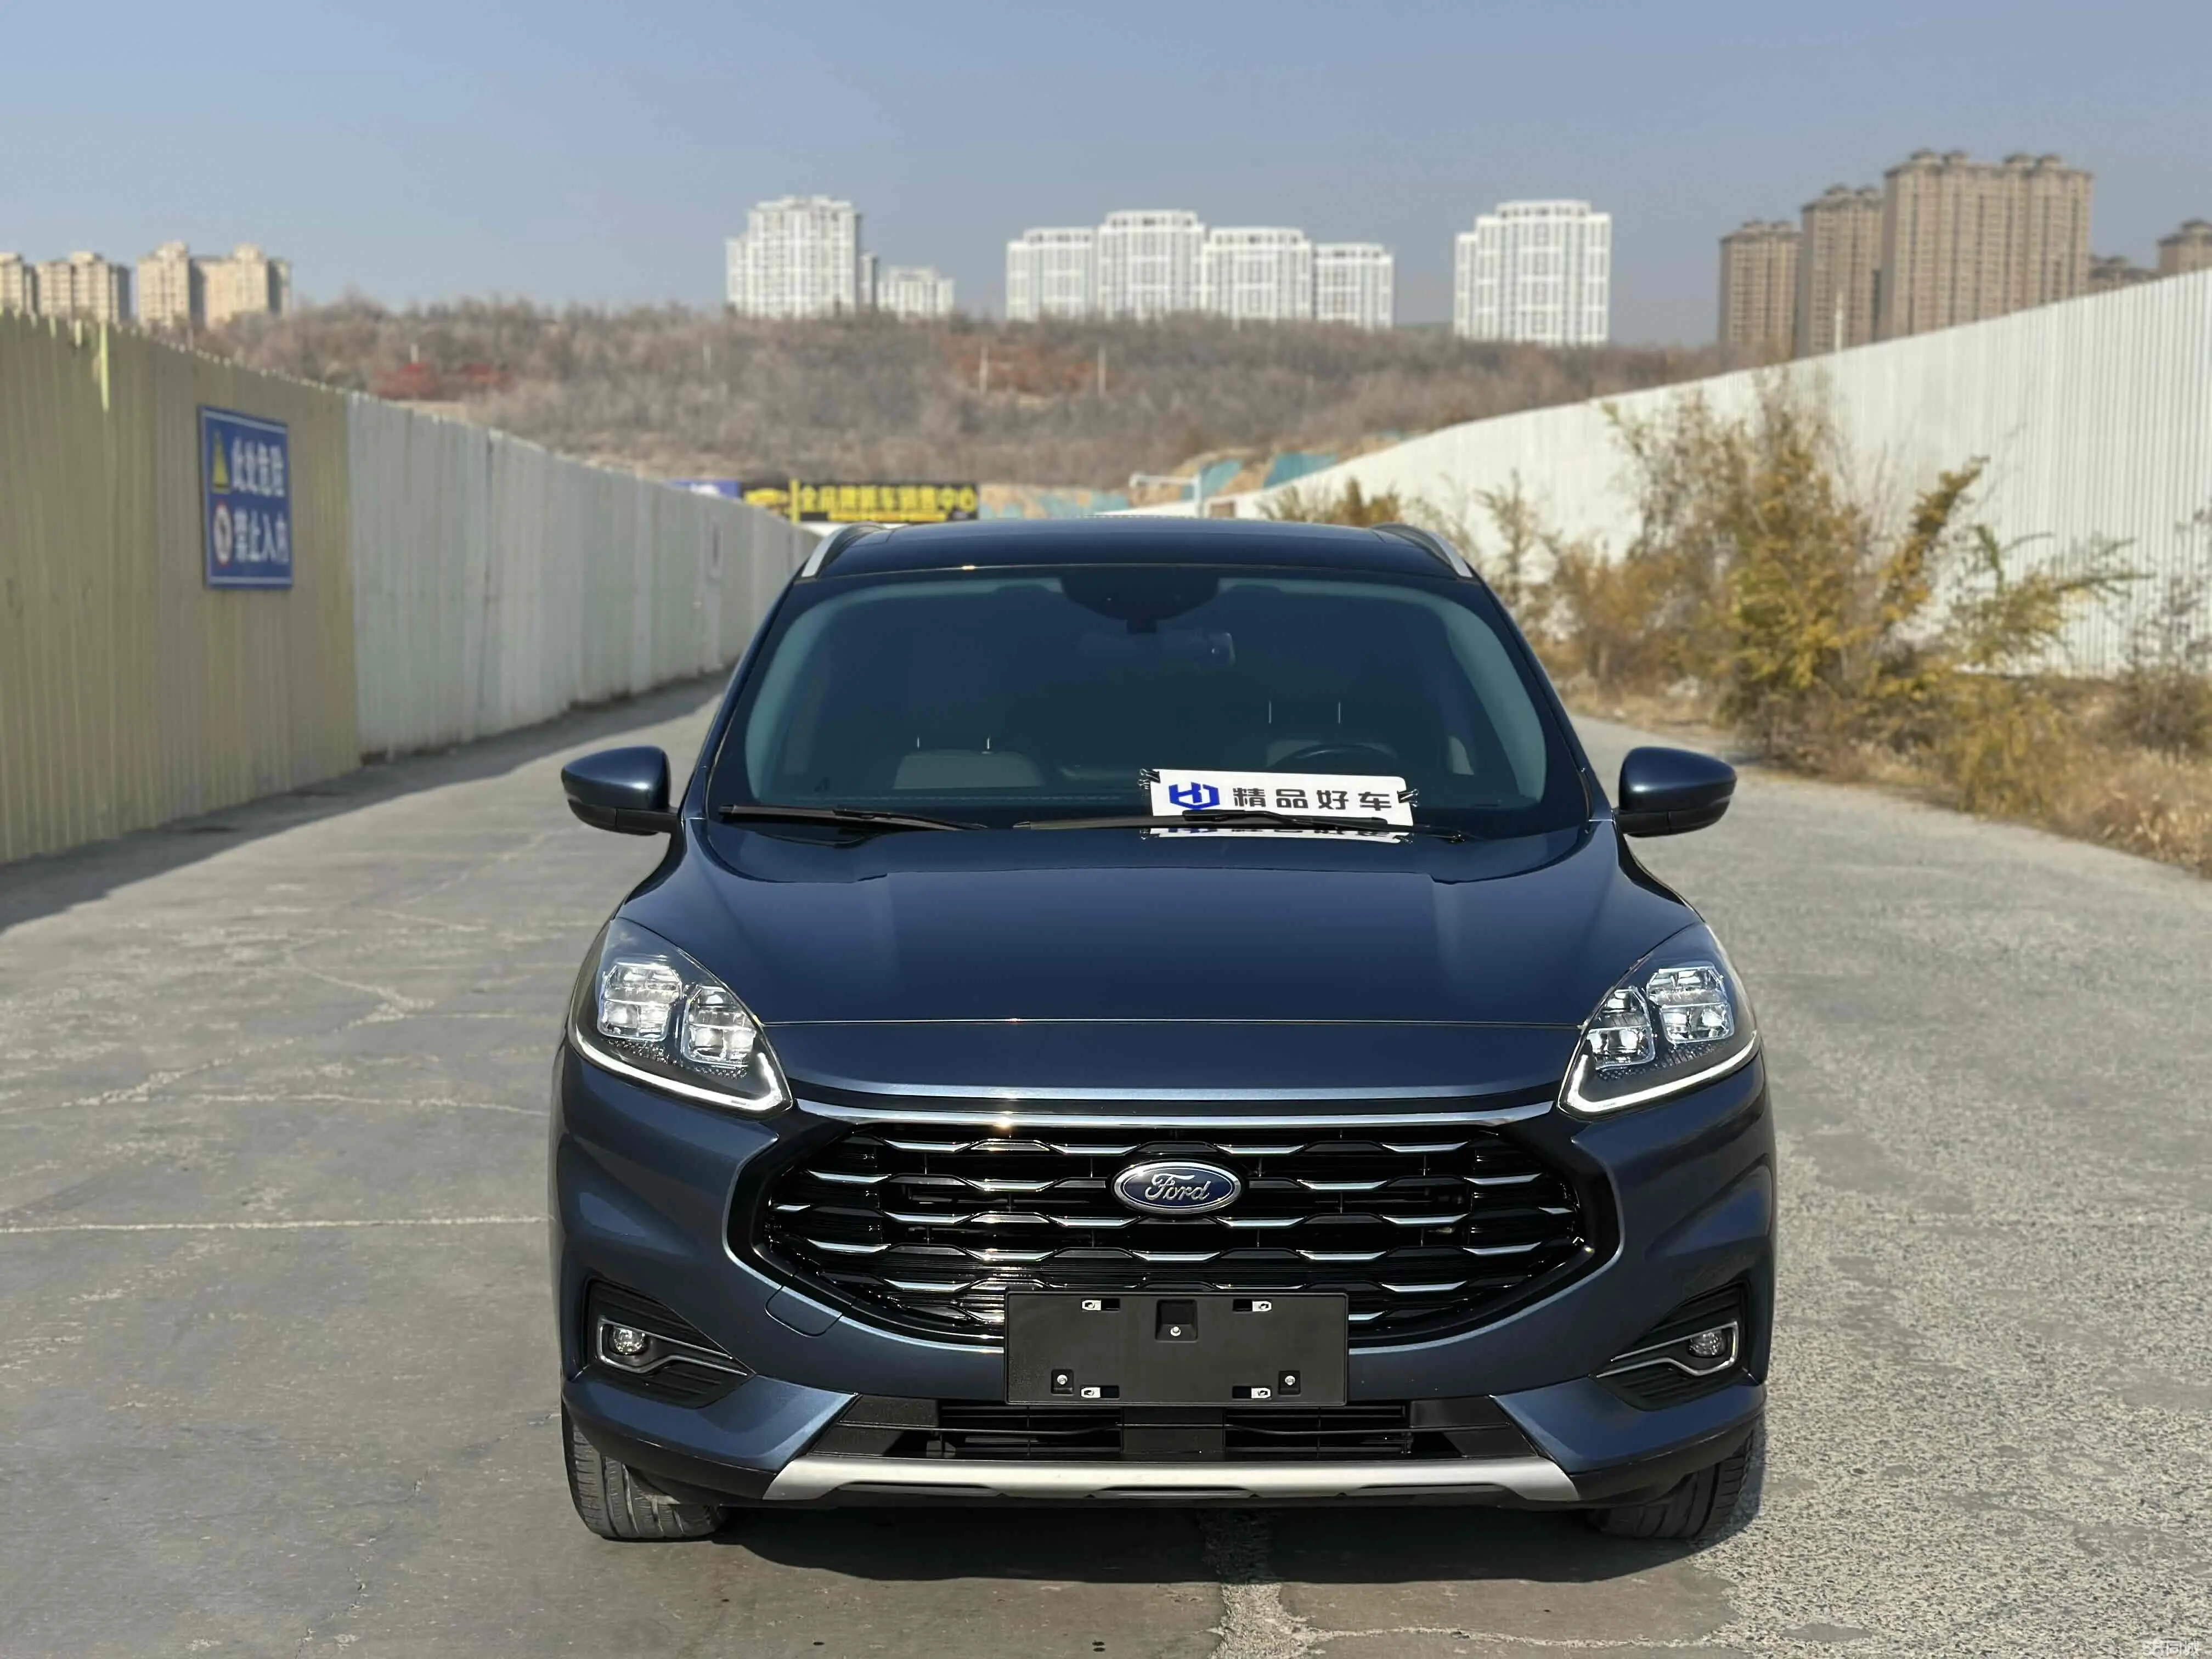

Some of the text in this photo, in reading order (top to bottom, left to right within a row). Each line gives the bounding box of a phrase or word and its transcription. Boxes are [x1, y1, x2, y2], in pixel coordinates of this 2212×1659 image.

[1232, 787, 1392, 811] 精品好车
[1145, 1173, 1211, 1200] Ford
